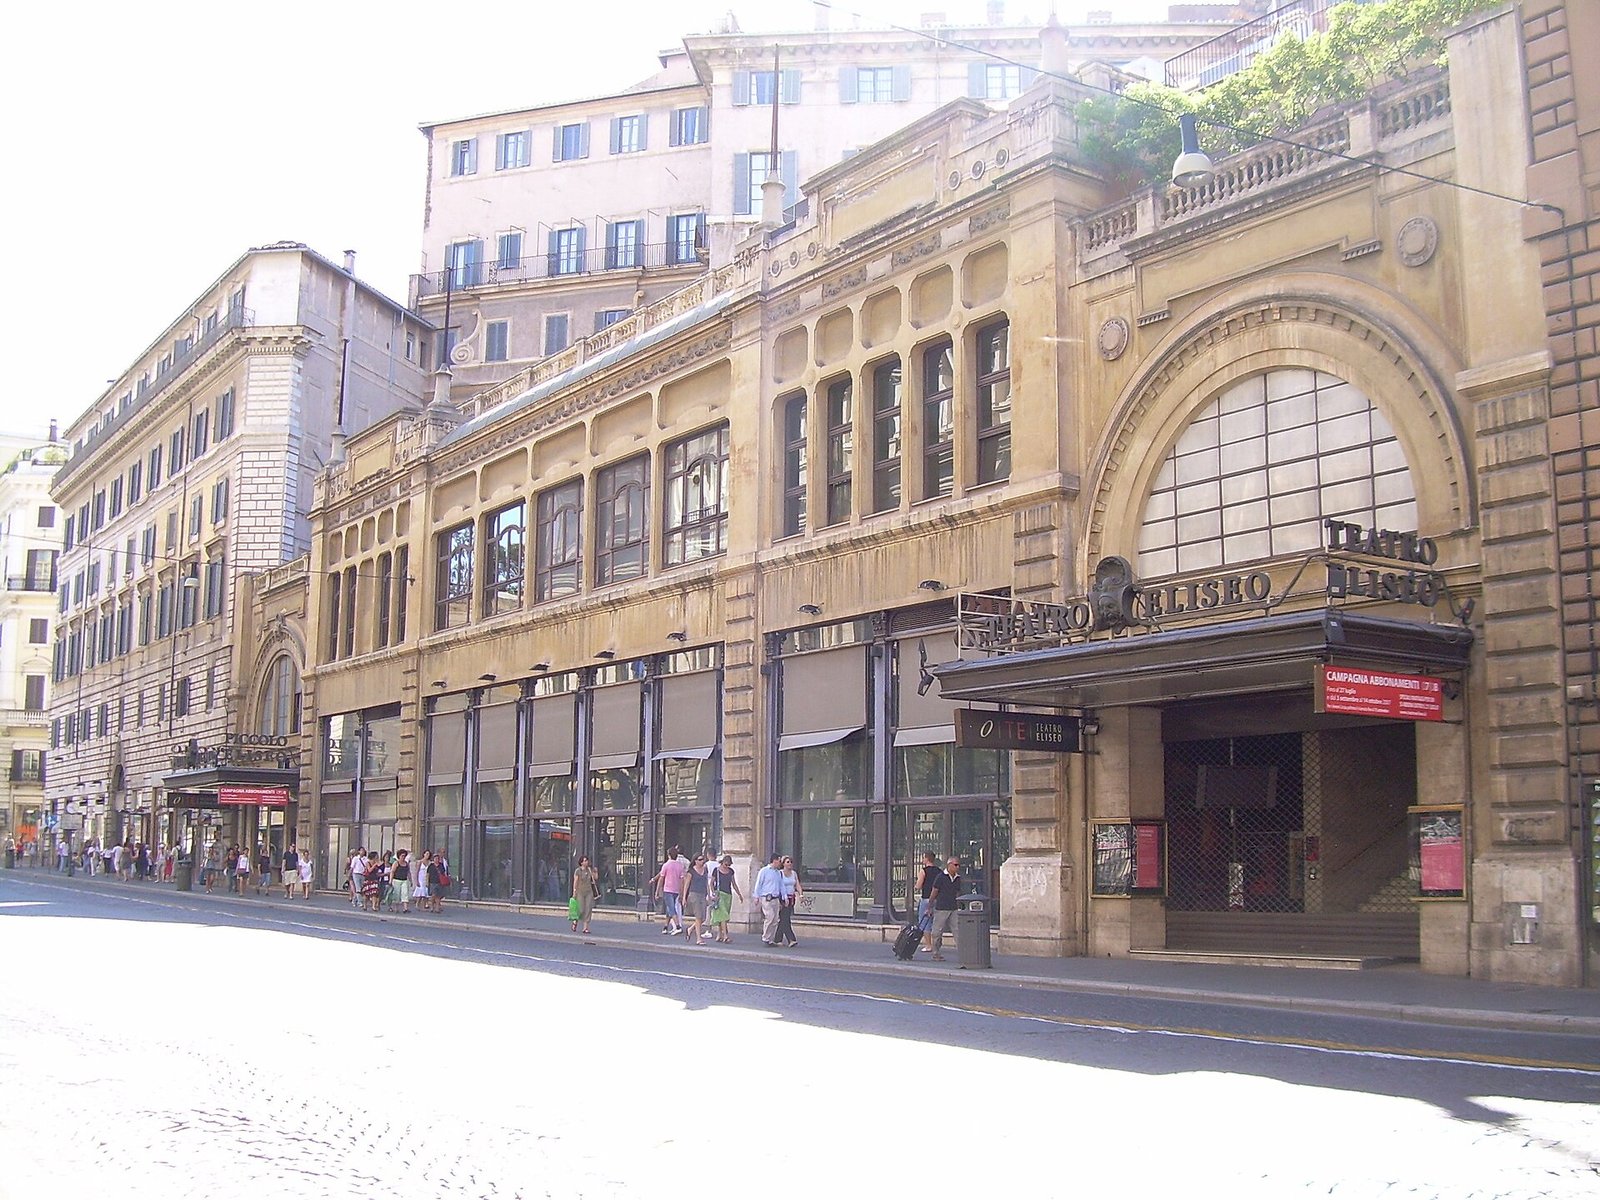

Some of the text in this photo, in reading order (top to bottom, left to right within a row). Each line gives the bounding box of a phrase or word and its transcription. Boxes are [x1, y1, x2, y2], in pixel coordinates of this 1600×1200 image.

[1324, 518, 1438, 565] TEATRO
[1326, 562, 1440, 607] LISEO
[984, 602, 1090, 641] TEATRO
[1143, 571, 1271, 616] ELISEO
[1326, 671, 1369, 685] CAMPAGNA
[1370, 675, 1420, 690] ABBONAMENTI
[1036, 723, 1062, 734] TEATRO
[1036, 733, 1063, 743] ELISEO
[226, 733, 288, 747] PICCOLO
